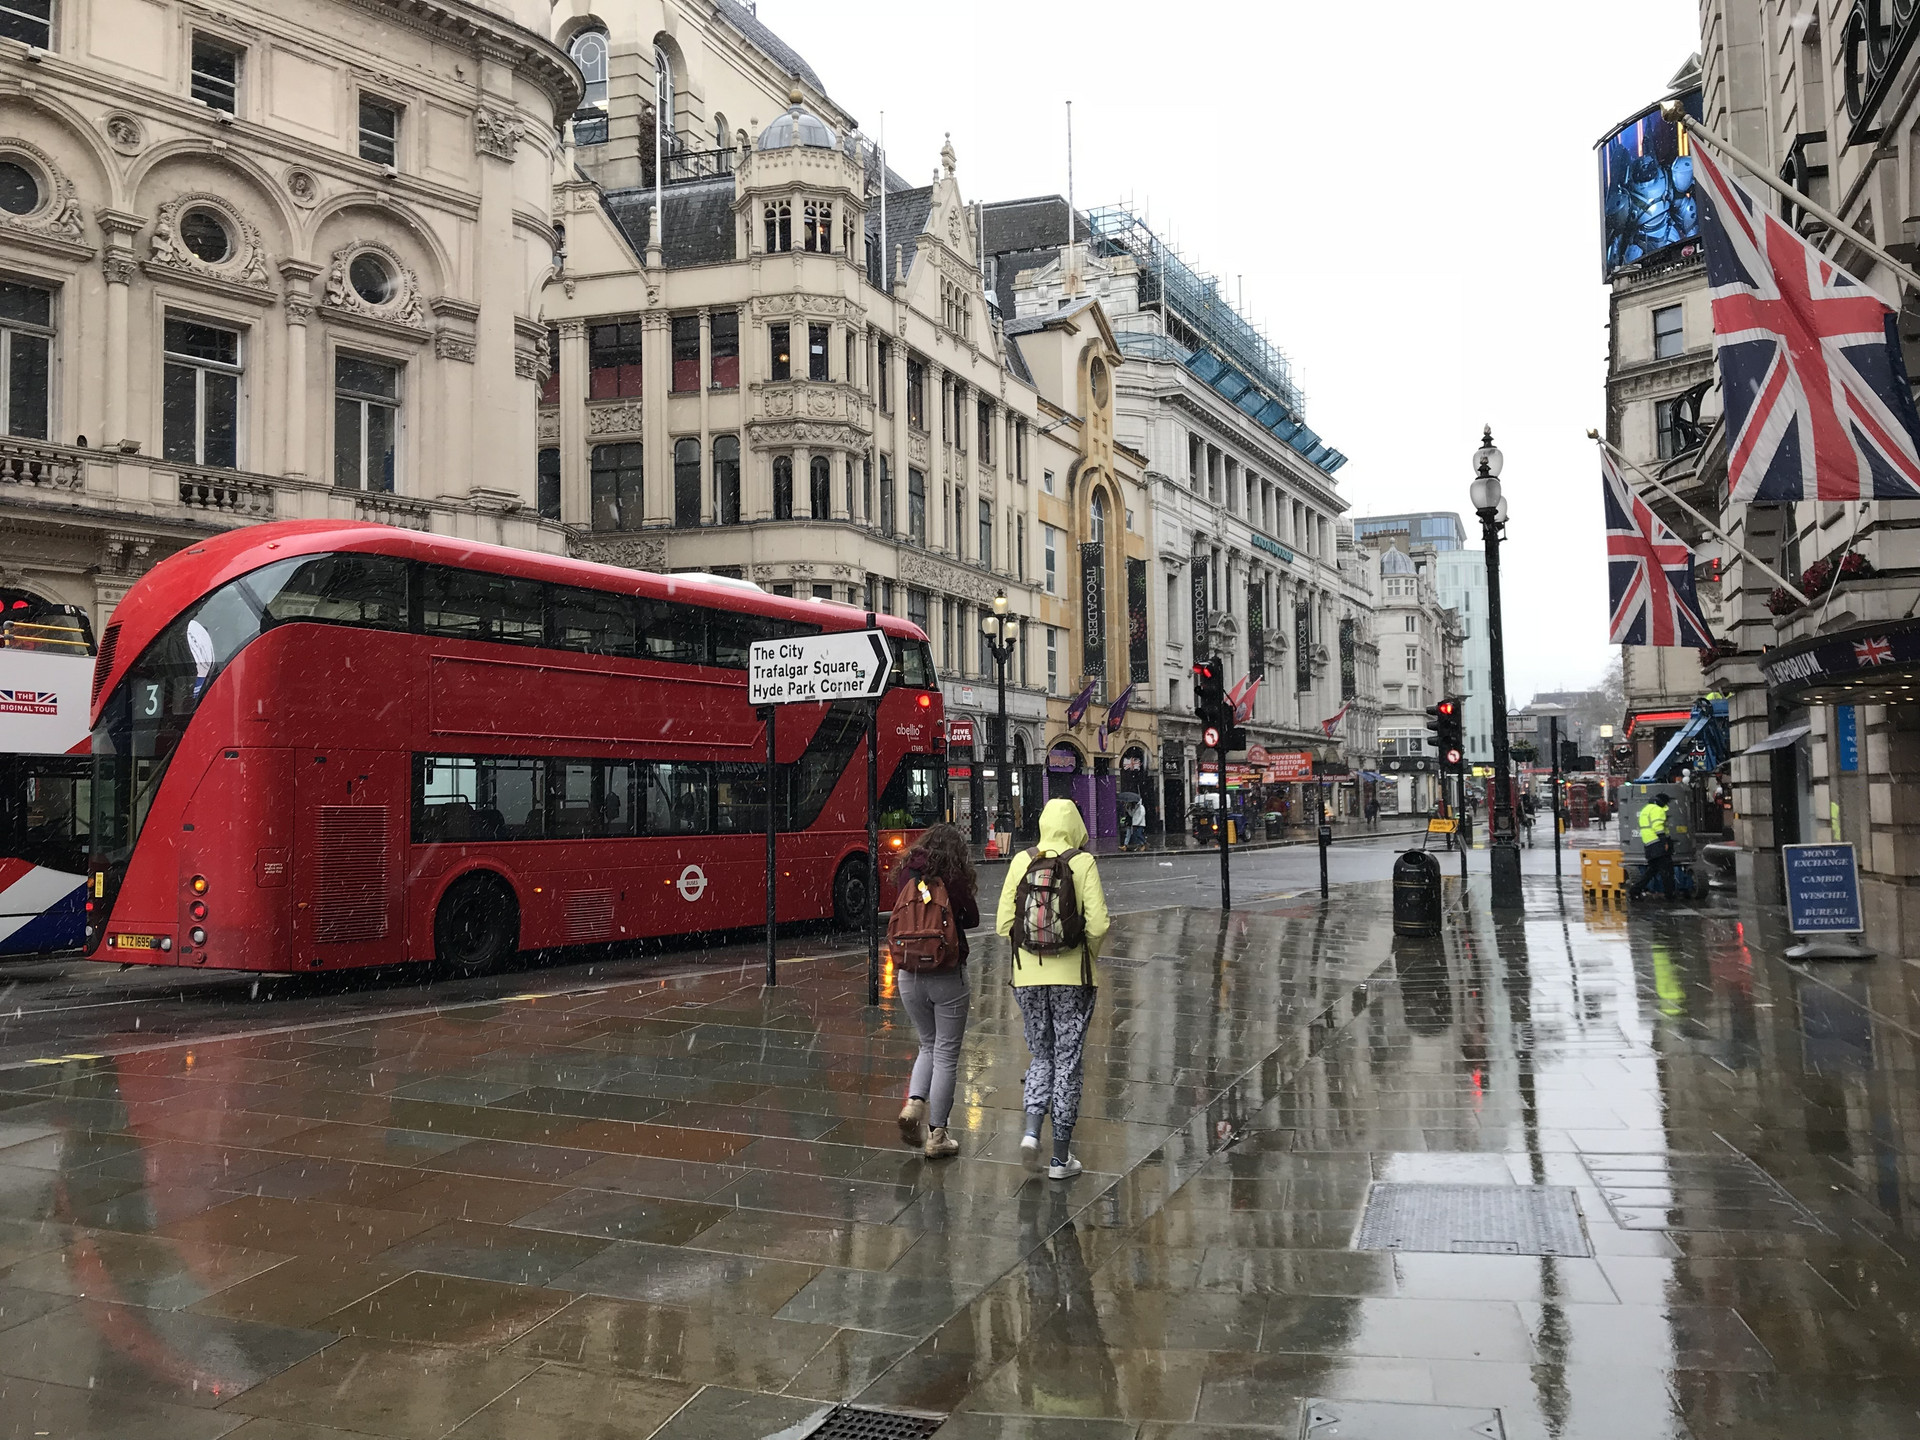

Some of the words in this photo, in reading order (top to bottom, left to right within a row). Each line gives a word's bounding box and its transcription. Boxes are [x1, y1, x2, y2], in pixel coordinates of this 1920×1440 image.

[1086, 566, 1099, 646] TROCADERO
[1195, 576, 1205, 643] TROCADERO
[754, 647, 775, 660] The
[779, 644, 804, 659] City
[754, 664, 808, 679] Trafalgar
[814, 660, 859, 676] Square
[1772, 651, 1823, 683] EMPORIUM
[753, 682, 783, 699] Hyde
[788, 681, 816, 695] Park
[820, 679, 864, 693] Corner
[145, 684, 159, 716] 3
[0, 704, 33, 712] RIGINAL
[896, 722, 920, 736] abellio
[1802, 849, 1839, 857] MONEY
[1794, 858, 1848, 867] EXCHANGE
[1801, 875, 1843, 883] CAMBIO
[1805, 908, 1847, 916] BUREAU
[1813, 917, 1856, 925] CHANGE
